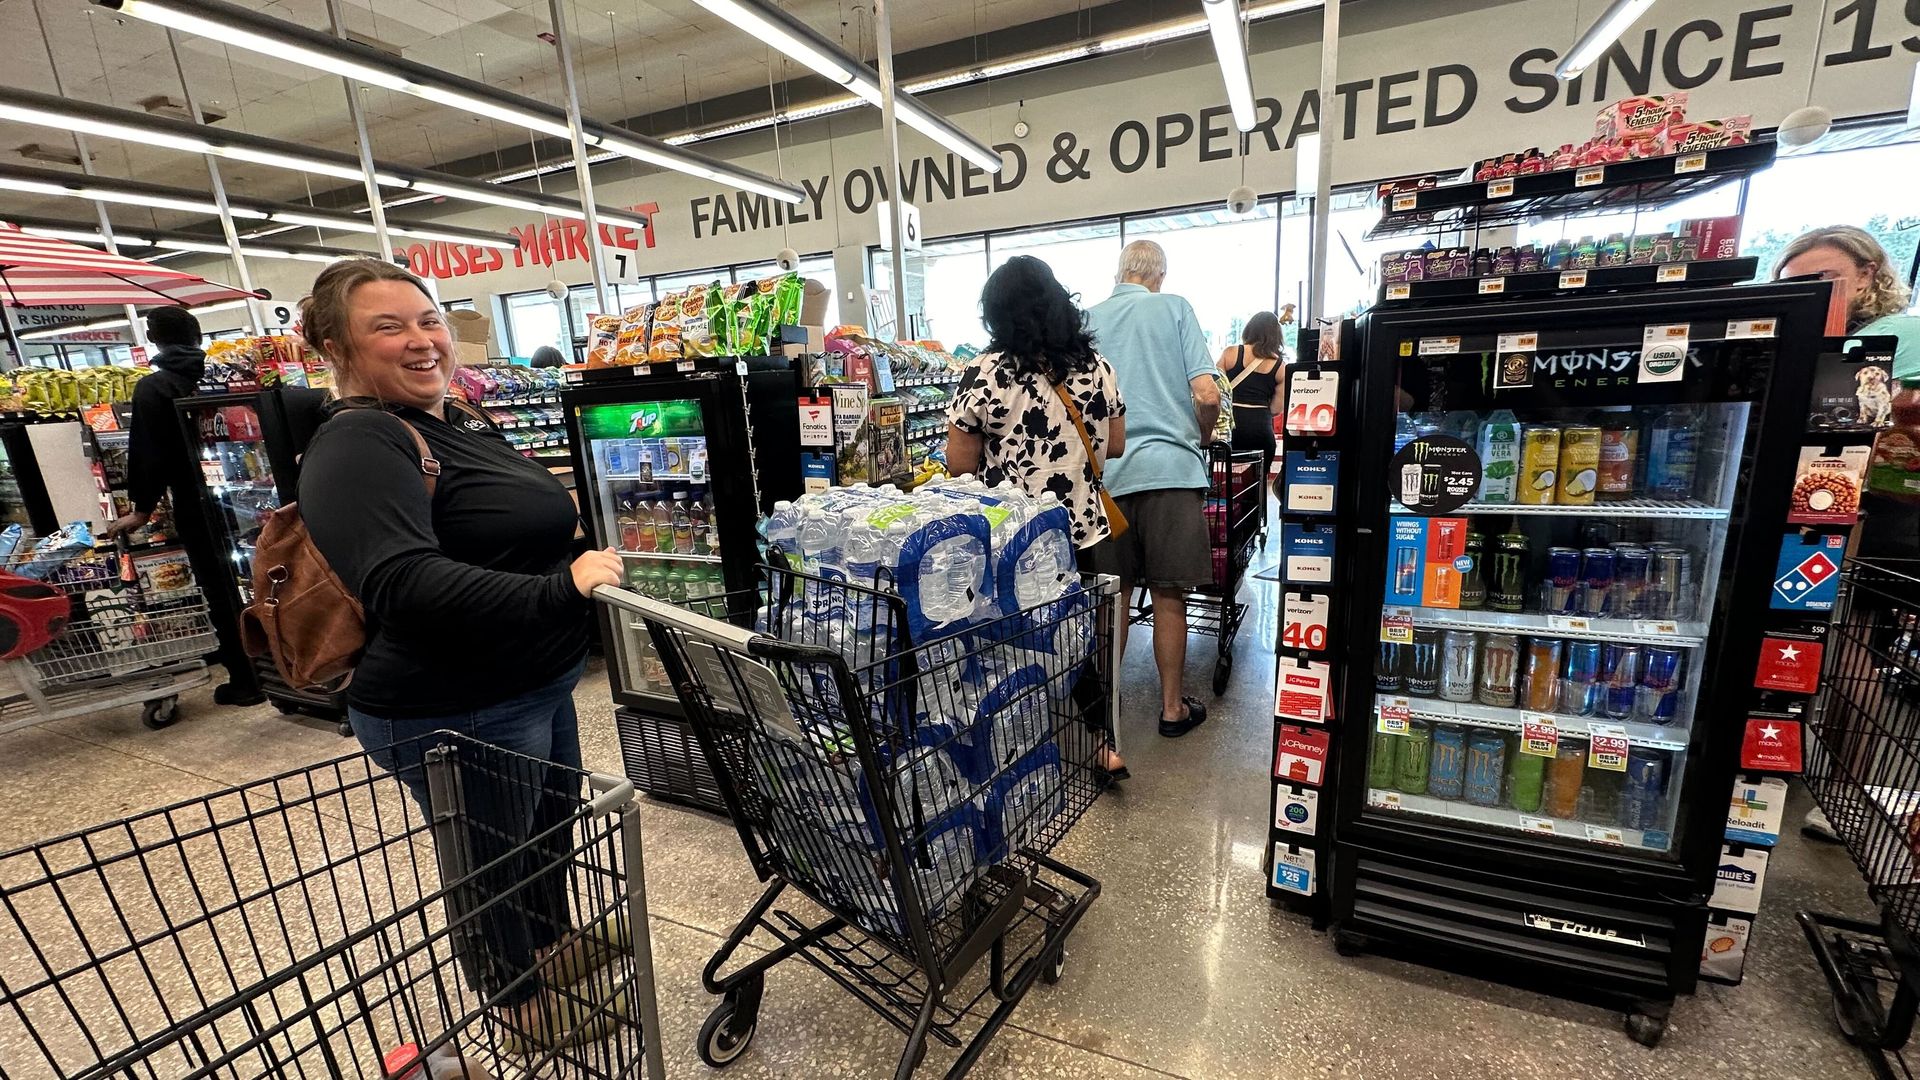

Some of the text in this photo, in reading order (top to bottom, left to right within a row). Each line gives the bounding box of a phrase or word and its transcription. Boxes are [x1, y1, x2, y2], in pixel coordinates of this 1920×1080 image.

[1666, 96, 1674, 105] 6
[1635, 106, 1664, 119] 5-hour
[690, 174, 829, 239] FAMILY
[843, 142, 1027, 215] OWNED
[1046, 131, 1091, 184] &
[1109, 63, 1478, 174] OPERATED
[1503, 3, 1793, 114] SINCE
[1629, 113, 1664, 127] ENERGY
[1725, 119, 1733, 129] 6
[1686, 130, 1722, 145] 5-hour
[1417, 178, 1426, 187] 6
[906, 212, 916, 242] 6
[1404, 251, 1412, 260] 6
[1448, 249, 1457, 258] 6
[394, 241, 503, 280] OUSES
[614, 254, 628, 279] 7
[31, 313, 90, 326] SHOPP
[274, 306, 291, 325] 9
[1533, 347, 1703, 376] MONSR
[1653, 351, 1676, 360] USDA
[1554, 376, 1630, 388] ENER
[629, 409, 657, 434] 7UP
[1428, 446, 1467, 454] MONSTER
[1443, 476, 1474, 486] $2.45
[1395, 527, 1422, 535] WITHOUT
[811, 596, 844, 610] SPRNG
[1287, 607, 1313, 615] verizon
[1811, 625, 1826, 633] $50
[1525, 723, 1556, 735] $2.99
[1281, 739, 1325, 756] JCPenney
[1530, 739, 1550, 747] BEST
[1595, 736, 1626, 748] $2.99
[1288, 805, 1305, 815] 200
[1726, 817, 1766, 830] Reloadit
[1281, 869, 1300, 883] $25
[1716, 869, 1752, 882] OWE'S
